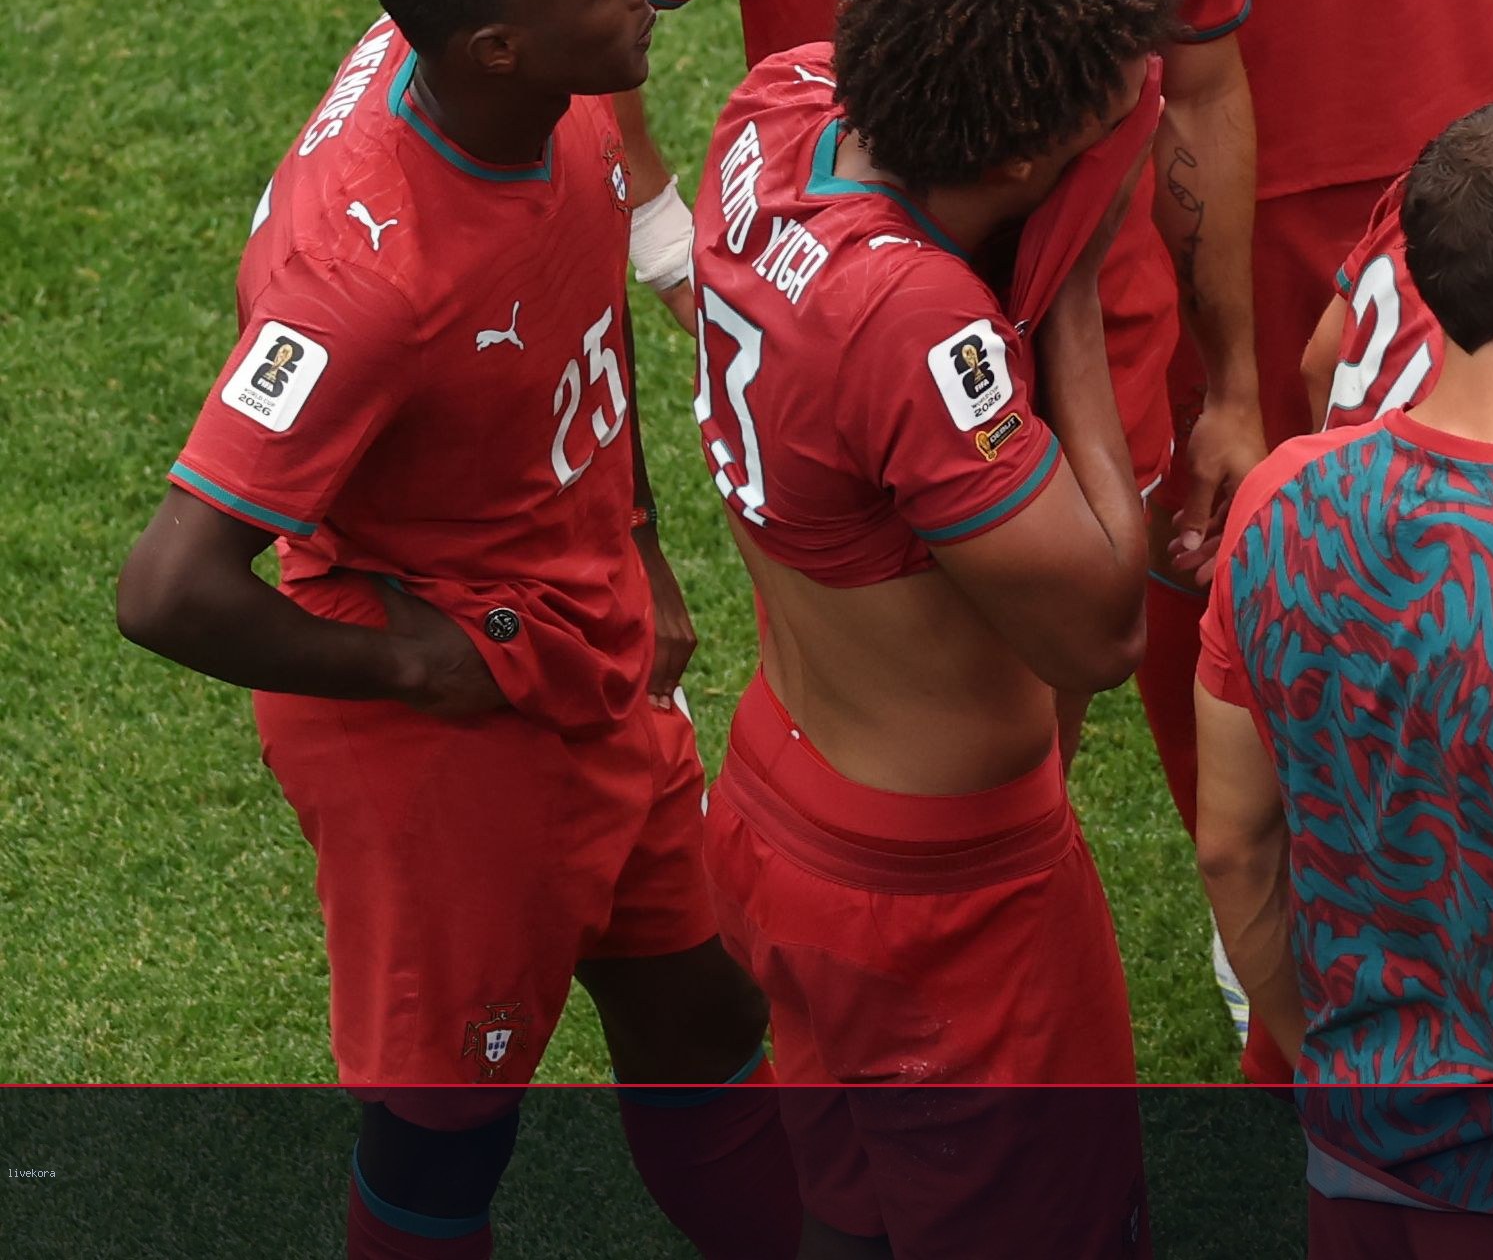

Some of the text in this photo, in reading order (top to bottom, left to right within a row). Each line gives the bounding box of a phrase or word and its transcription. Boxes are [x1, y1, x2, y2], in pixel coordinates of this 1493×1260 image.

[238, 393, 272, 417] 2026
[551, 304, 627, 496] 25
[974, 391, 1002, 418] 2026
